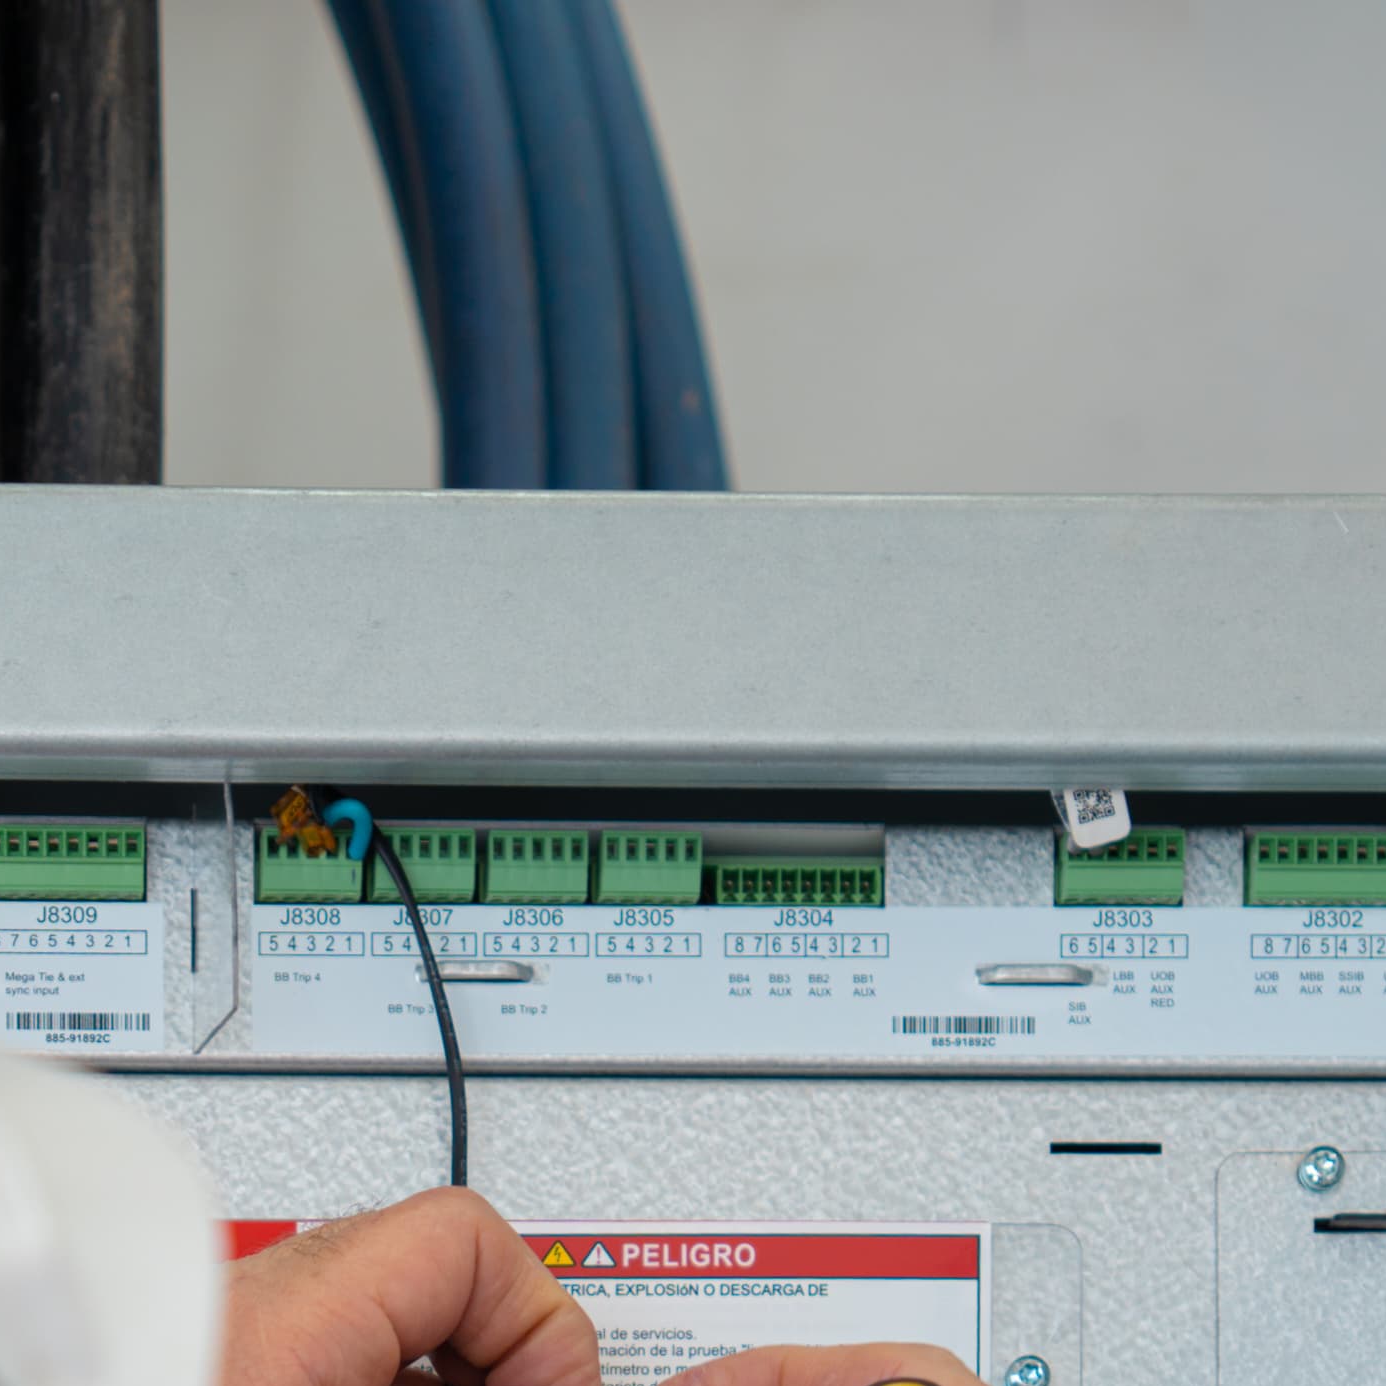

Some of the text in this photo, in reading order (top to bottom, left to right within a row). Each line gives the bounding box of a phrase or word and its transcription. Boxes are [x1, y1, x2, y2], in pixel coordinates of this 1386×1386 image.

[37, 906, 98, 924] J8309
[280, 908, 341, 926] J8308
[503, 909, 563, 926] J8306
[613, 910, 675, 926] J8305
[773, 910, 834, 926] J8304
[1093, 910, 1153, 928] J8303
[1303, 910, 1363, 928] J8302
[10, 934, 20, 948] 7
[29, 934, 39, 948] 6
[48, 934, 58, 948] 5
[66, 934, 76, 948] 4
[85, 934, 95, 948] 3
[104, 934, 114, 948] 2
[124, 934, 131, 948] 1
[5, 972, 85, 984] Mega Tie & ext
[274, 972, 321, 984] BB Trip 4
[607, 973, 653, 985] BB Trip 1
[853, 974, 874, 984] BB1
[5, 985, 59, 996] sync input
[729, 987, 751, 997] AUX
[769, 987, 792, 997] AUX
[808, 987, 831, 997] AUX
[853, 987, 876, 997] AUX
[1113, 984, 1136, 994] AUX
[1151, 985, 1173, 994] AUX
[1254, 985, 1277, 994] AUX
[1300, 985, 1323, 994] AUX
[1338, 985, 1362, 994] AUX
[1069, 1002, 1087, 1012] SIB
[1151, 998, 1175, 1008] RED
[387, 1004, 435, 1016] BB Trip 3
[501, 1004, 548, 1016] BB Trip 2
[1069, 1015, 1091, 1025] AUX
[45, 1034, 111, 1043] 885-91892C
[931, 1037, 996, 1047] 885-91892C
[622, 1243, 756, 1268] PELIGRO
[562, 1284, 611, 1298] TRICA,
[703, 1284, 715, 1296] O
[719, 1284, 805, 1297] DESCARGA
[808, 1284, 829, 1296] DE
[597, 1328, 697, 1340] al de servicios.
[600, 1344, 645, 1356] mación
[650, 1344, 667, 1356] de
[671, 1344, 684, 1356] la
[688, 1344, 737, 1360] prueba
[601, 1364, 650, 1376] tímetro
[654, 1366, 671, 1376] en
